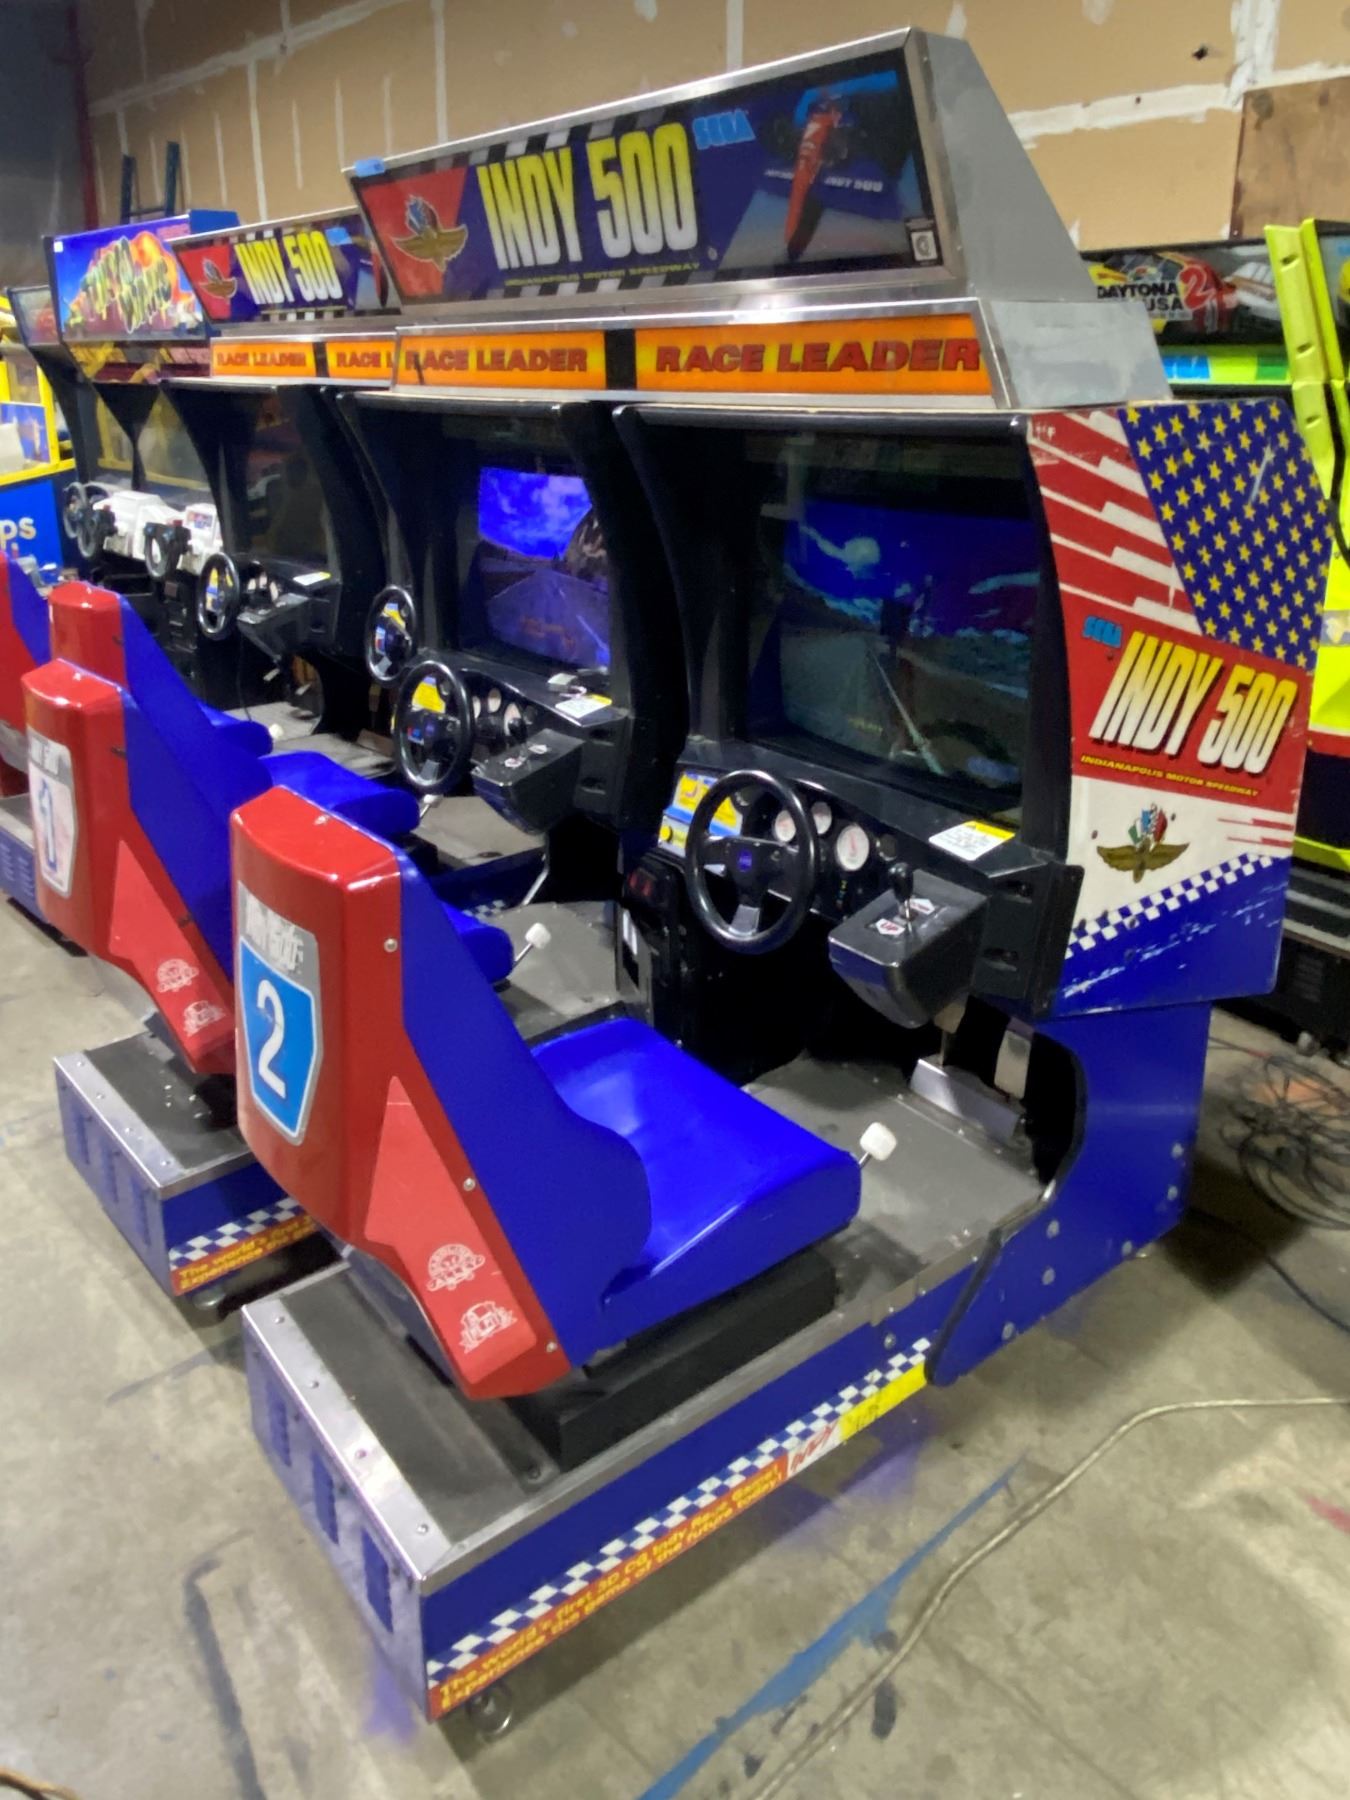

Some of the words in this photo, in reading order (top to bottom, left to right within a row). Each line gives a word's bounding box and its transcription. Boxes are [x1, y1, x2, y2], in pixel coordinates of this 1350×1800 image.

[476, 146, 583, 270] INDY
[586, 122, 698, 258] 500
[234, 238, 295, 304] INDY
[282, 230, 344, 302] 500
[1097, 282, 1178, 299] DAYTONA
[336, 352, 382, 368] RACE
[405, 348, 470, 372] RACE
[475, 347, 588, 372] LEADER
[655, 342, 766, 372] RACE
[776, 337, 981, 373] LEADER
[1088, 630, 1224, 757] INDY
[1197, 664, 1298, 775] 500
[1081, 755, 1163, 779] INDIANAPOLIS
[1166, 772, 1204, 786] MOTOR
[258, 980, 286, 1099] 2
